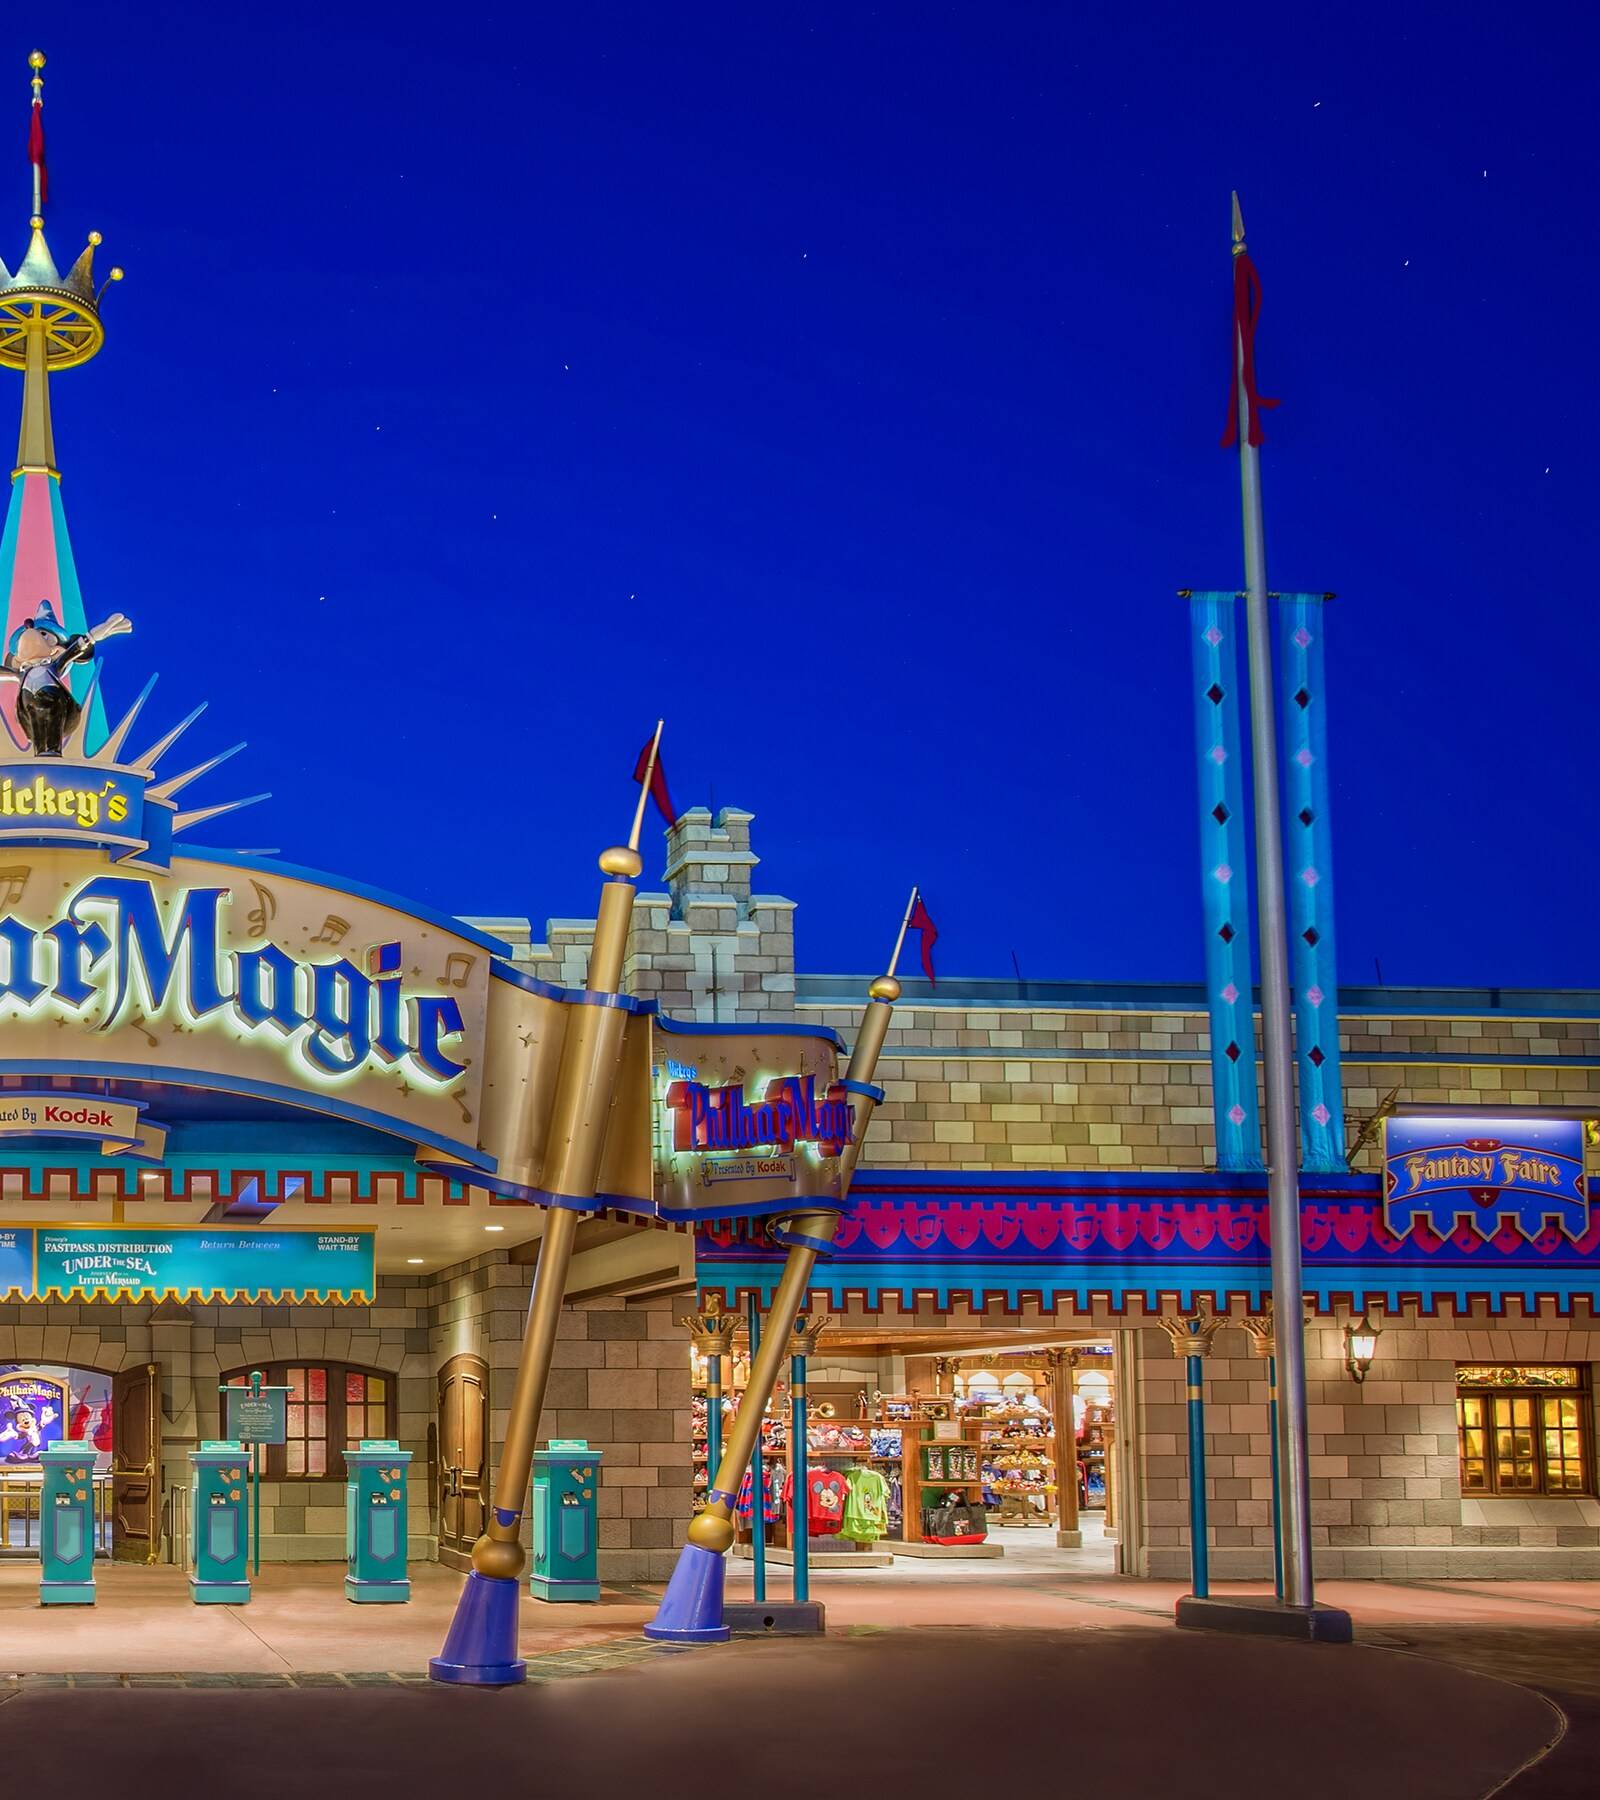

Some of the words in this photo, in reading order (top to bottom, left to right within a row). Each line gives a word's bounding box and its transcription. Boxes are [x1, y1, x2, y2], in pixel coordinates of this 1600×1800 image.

[22, 1107, 37, 1124] By
[44, 1106, 113, 1127] Kodak
[757, 1160, 786, 1173] Kodak
[1405, 1152, 1494, 1192] Fantasy
[1499, 1152, 1562, 1186] Faire
[200, 1240, 235, 1249] Return
[238, 1240, 280, 1249] Between
[317, 1236, 360, 1244] STAND-BY
[97, 1244, 173, 1254] DISTRIBUTION
[62, 1255, 112, 1275] UNDER
[126, 1256, 158, 1276] SEA
[79, 1275, 104, 1285] LITTLE
[104, 1272, 141, 1286] MERMAID
